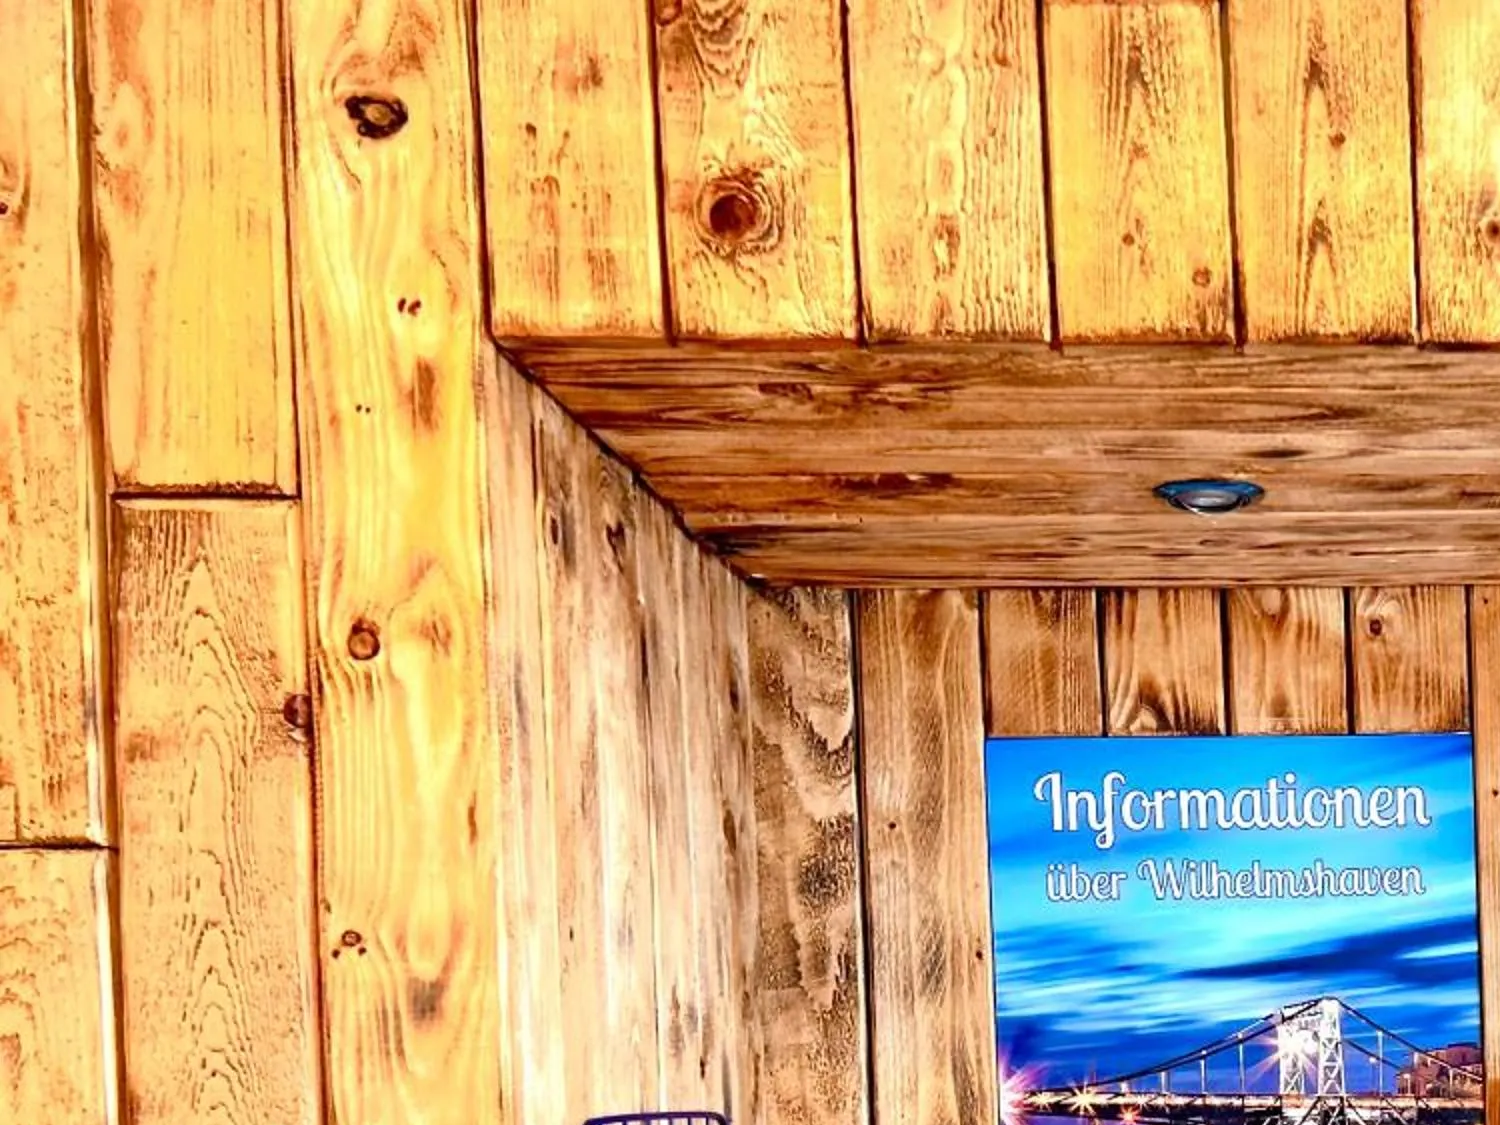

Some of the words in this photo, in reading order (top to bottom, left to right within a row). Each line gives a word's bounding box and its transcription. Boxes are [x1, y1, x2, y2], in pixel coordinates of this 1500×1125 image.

[1034, 771, 1431, 849] Informationen
[1046, 862, 1126, 901] über
[1137, 858, 1427, 900] Wilhelmshaven
